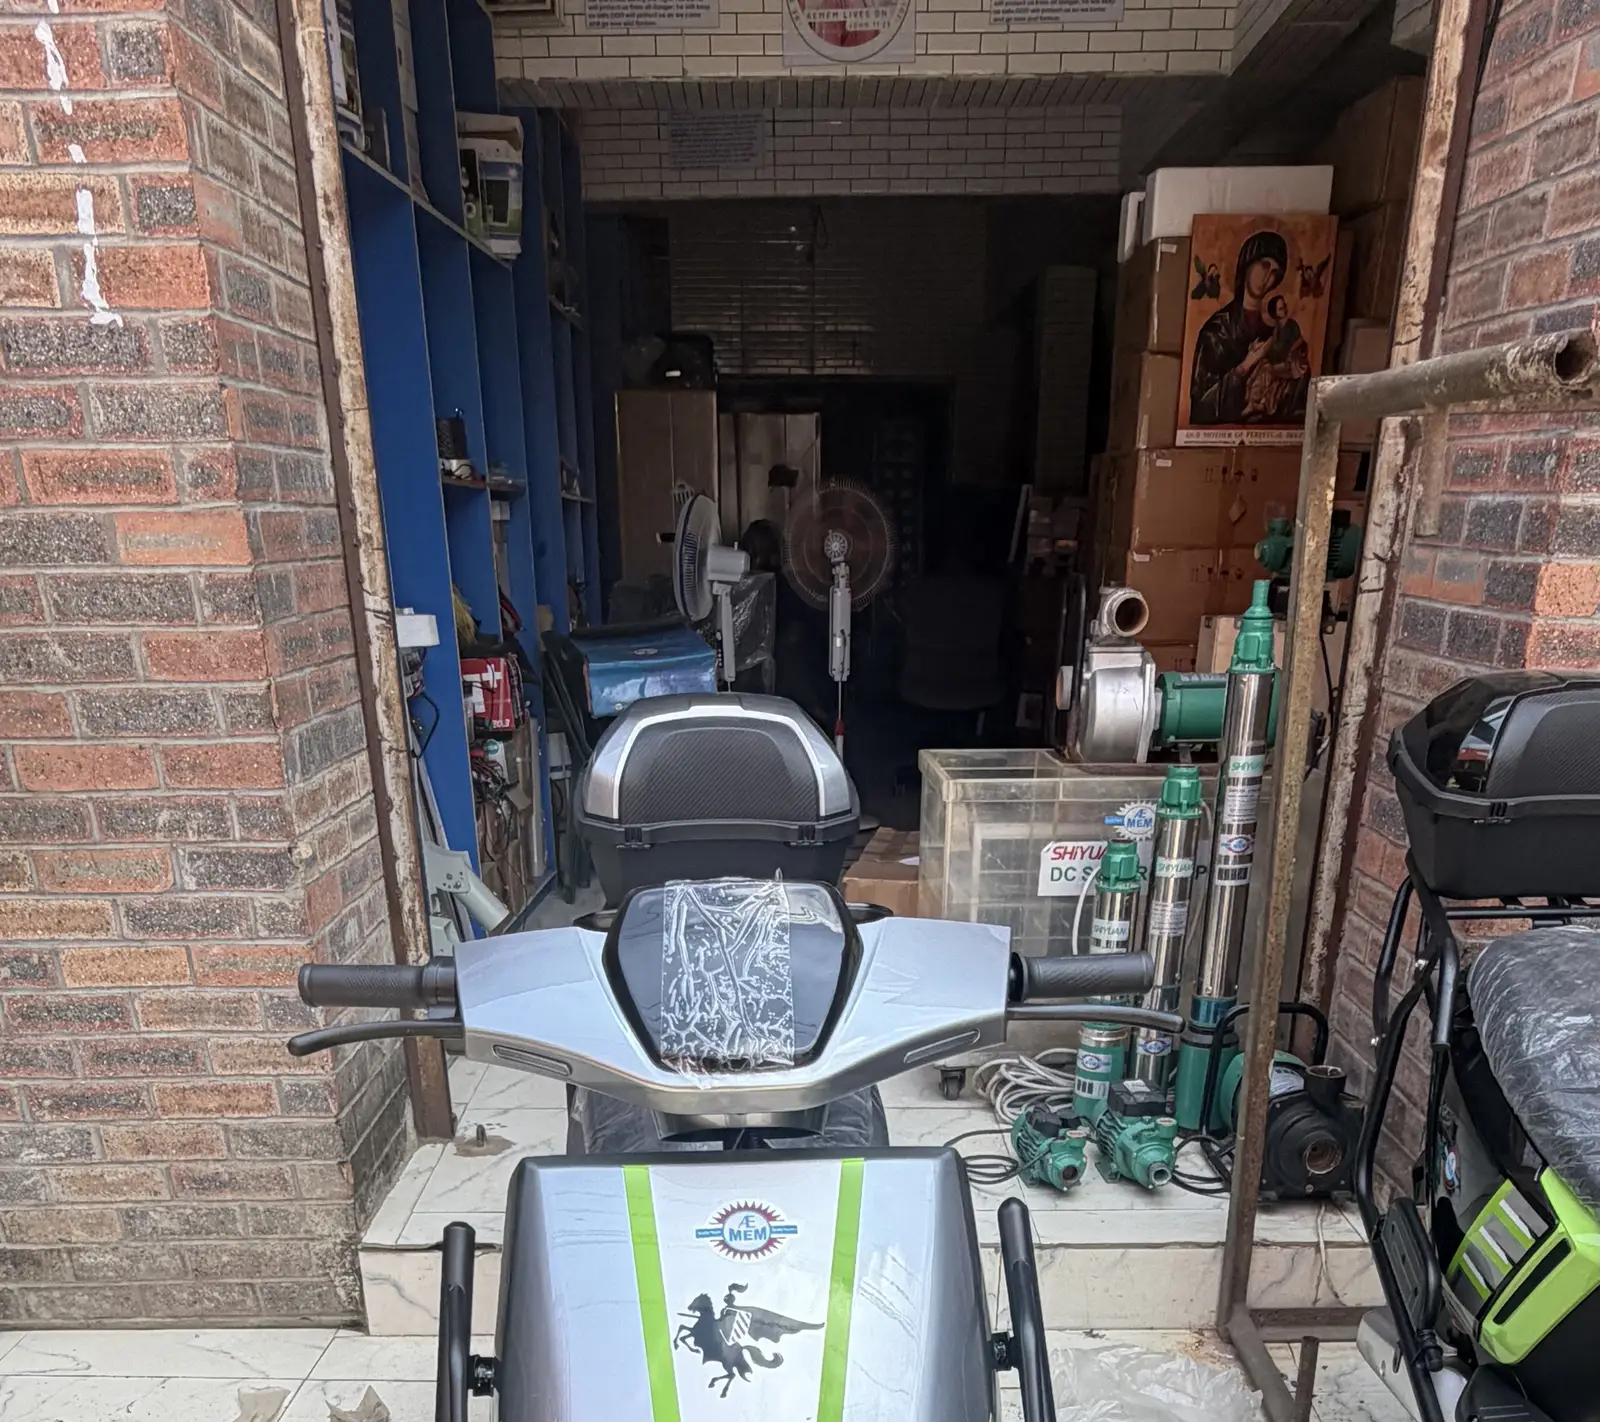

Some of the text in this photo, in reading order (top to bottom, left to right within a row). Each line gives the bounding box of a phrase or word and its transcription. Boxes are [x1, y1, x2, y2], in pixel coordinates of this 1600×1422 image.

[1126, 818, 1153, 828] MEM
[1050, 866, 1077, 881] DC
[728, 1226, 768, 1242] MEM
